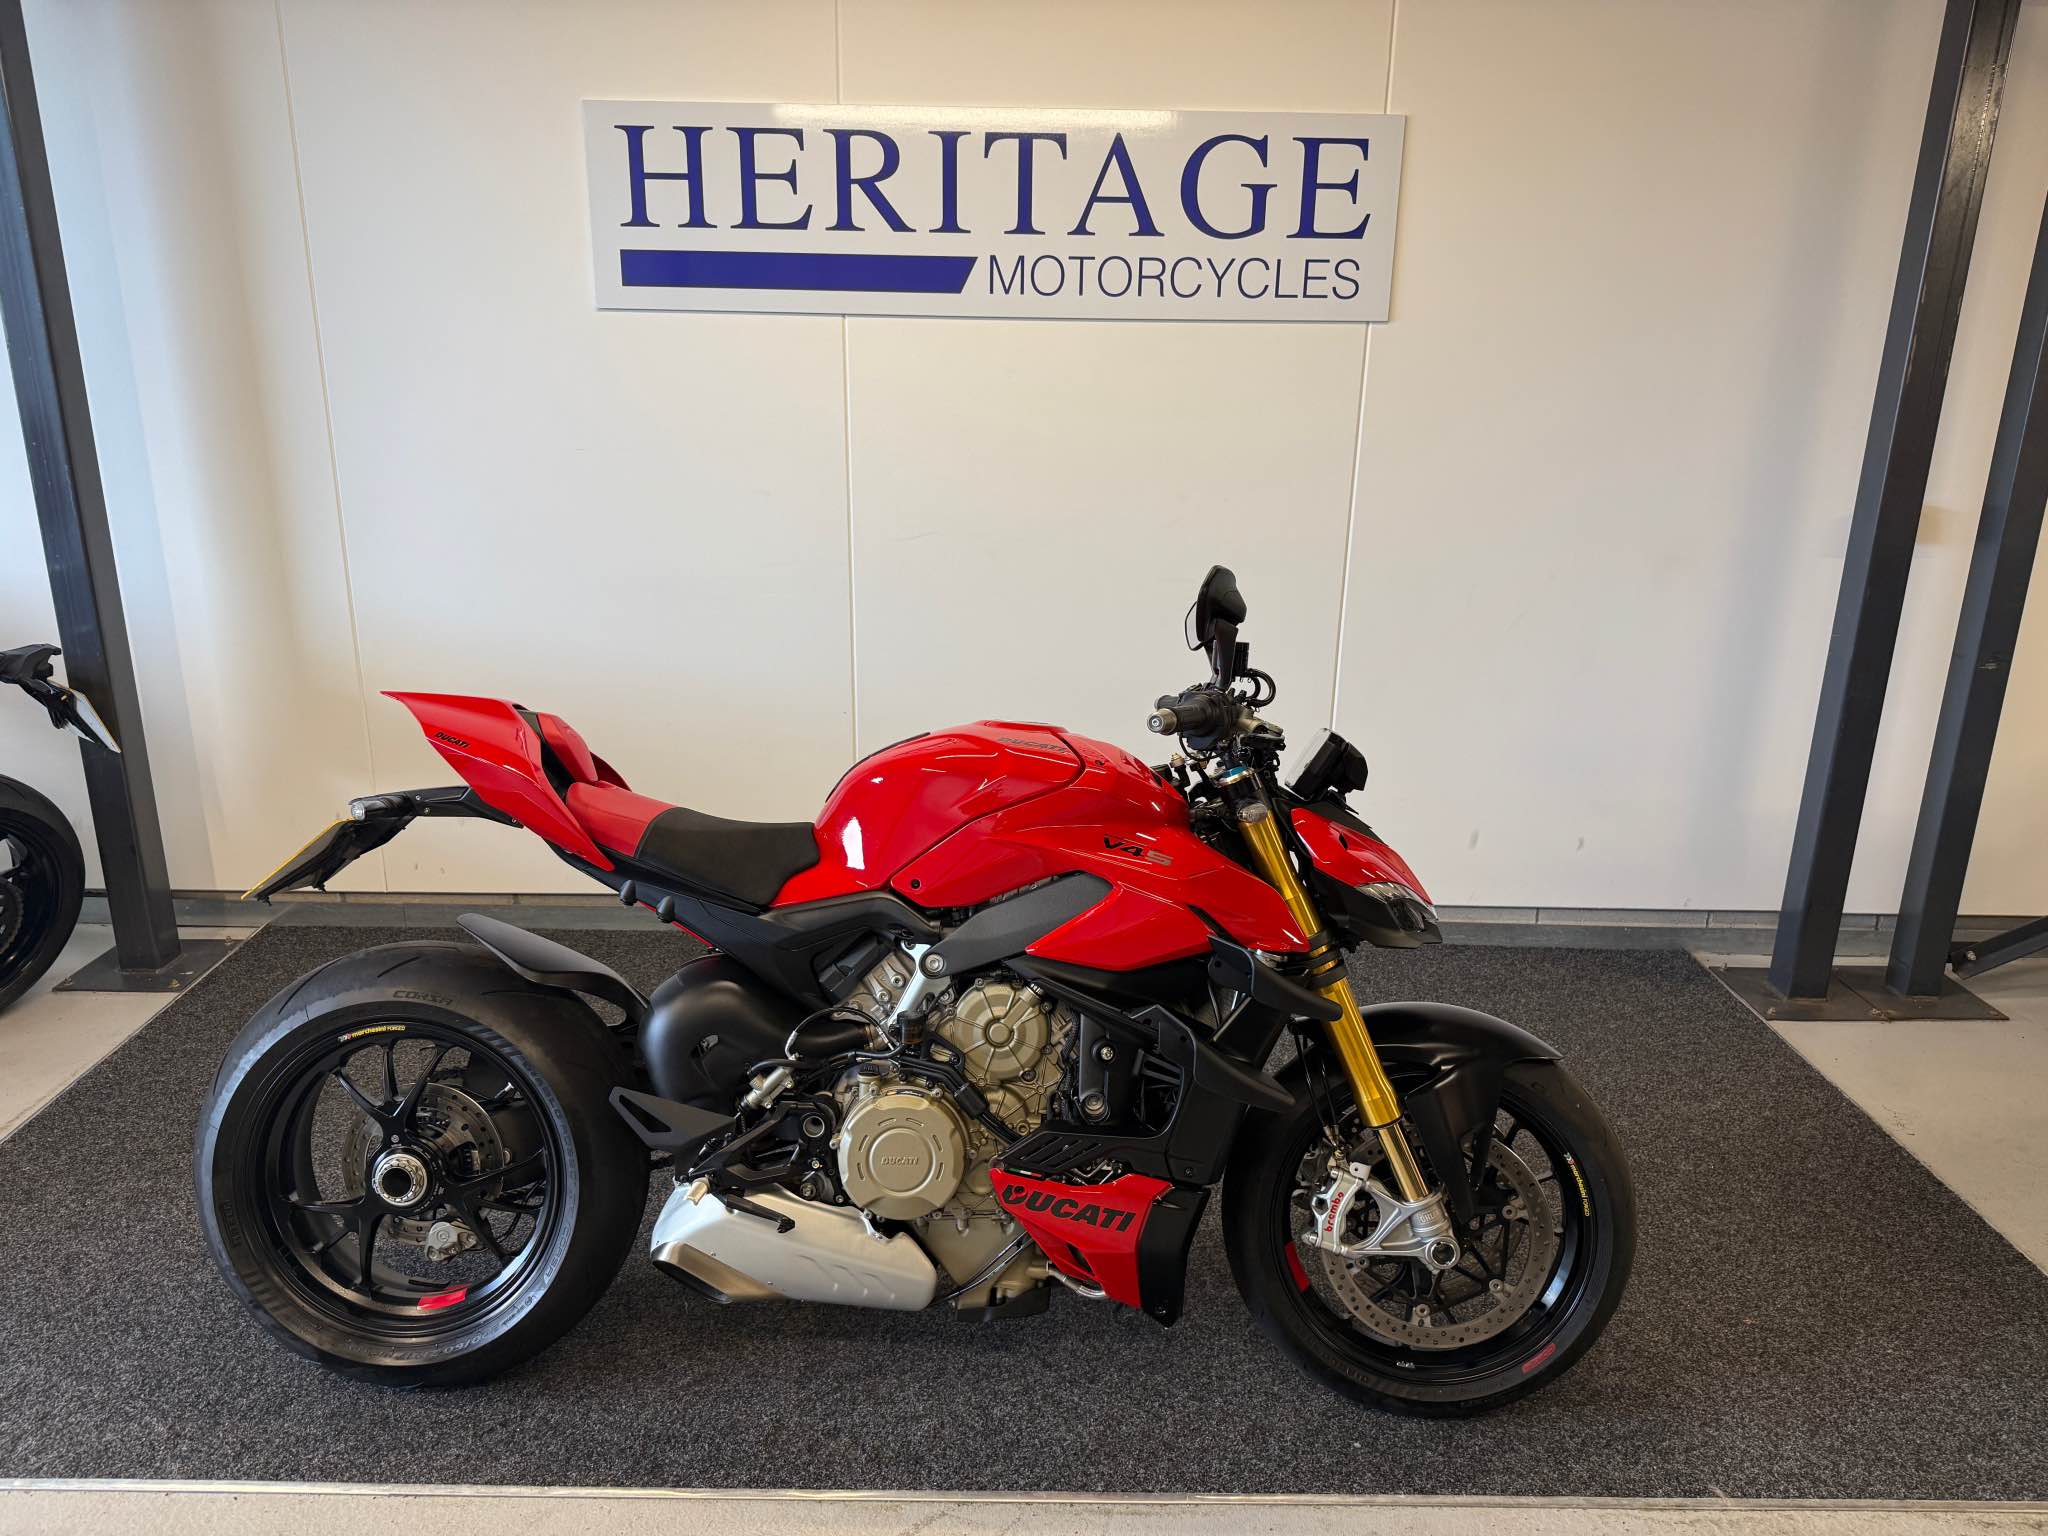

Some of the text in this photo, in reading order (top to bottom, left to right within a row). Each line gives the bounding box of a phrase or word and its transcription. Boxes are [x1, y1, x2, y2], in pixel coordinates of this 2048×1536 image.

[614, 124, 1371, 240] HERITAGE
[988, 254, 1361, 300] MOTORCYCLES
[435, 731, 470, 748] DUCATI
[998, 737, 1067, 753] DUCATI
[392, 990, 454, 1006] CORSA
[881, 1156, 919, 1166] DUCATI
[1002, 1184, 1136, 1232] DUCATI
[1324, 1191, 1344, 1232] brembo
